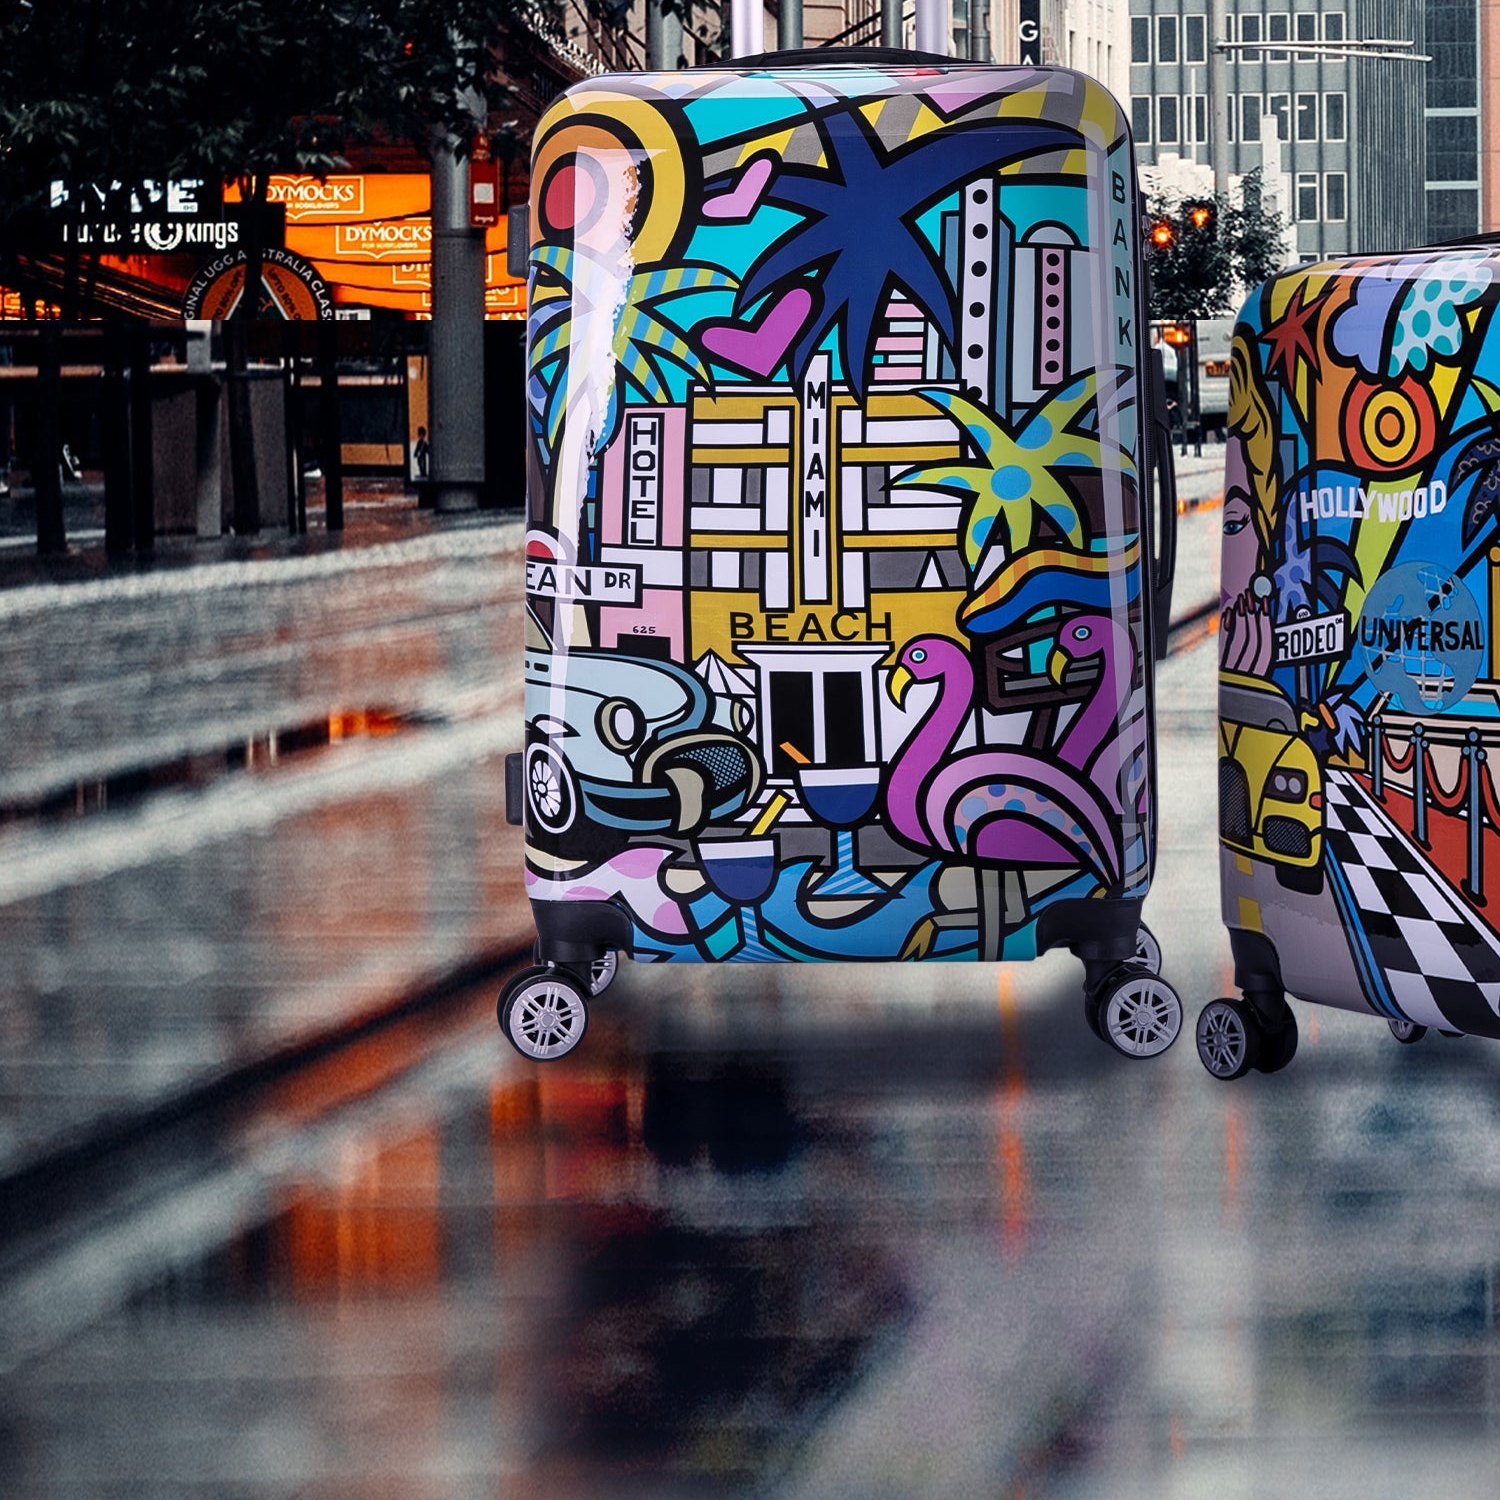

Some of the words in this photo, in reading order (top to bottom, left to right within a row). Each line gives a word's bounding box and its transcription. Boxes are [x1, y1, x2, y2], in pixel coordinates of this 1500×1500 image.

[345, 225, 432, 242] DYMOCKS
[203, 254, 234, 278] UGG
[1111, 170, 1134, 349] BANK
[632, 420, 658, 546] HOTEL
[806, 380, 827, 557] MIAMI
[1299, 479, 1447, 523] HOLLYWOOD
[604, 571, 632, 590] DR
[632, 625, 657, 635] 625
[729, 611, 893, 642] BEACH
[1276, 623, 1336, 662] RODEO
[1361, 615, 1485, 652] UNIVERSAL
